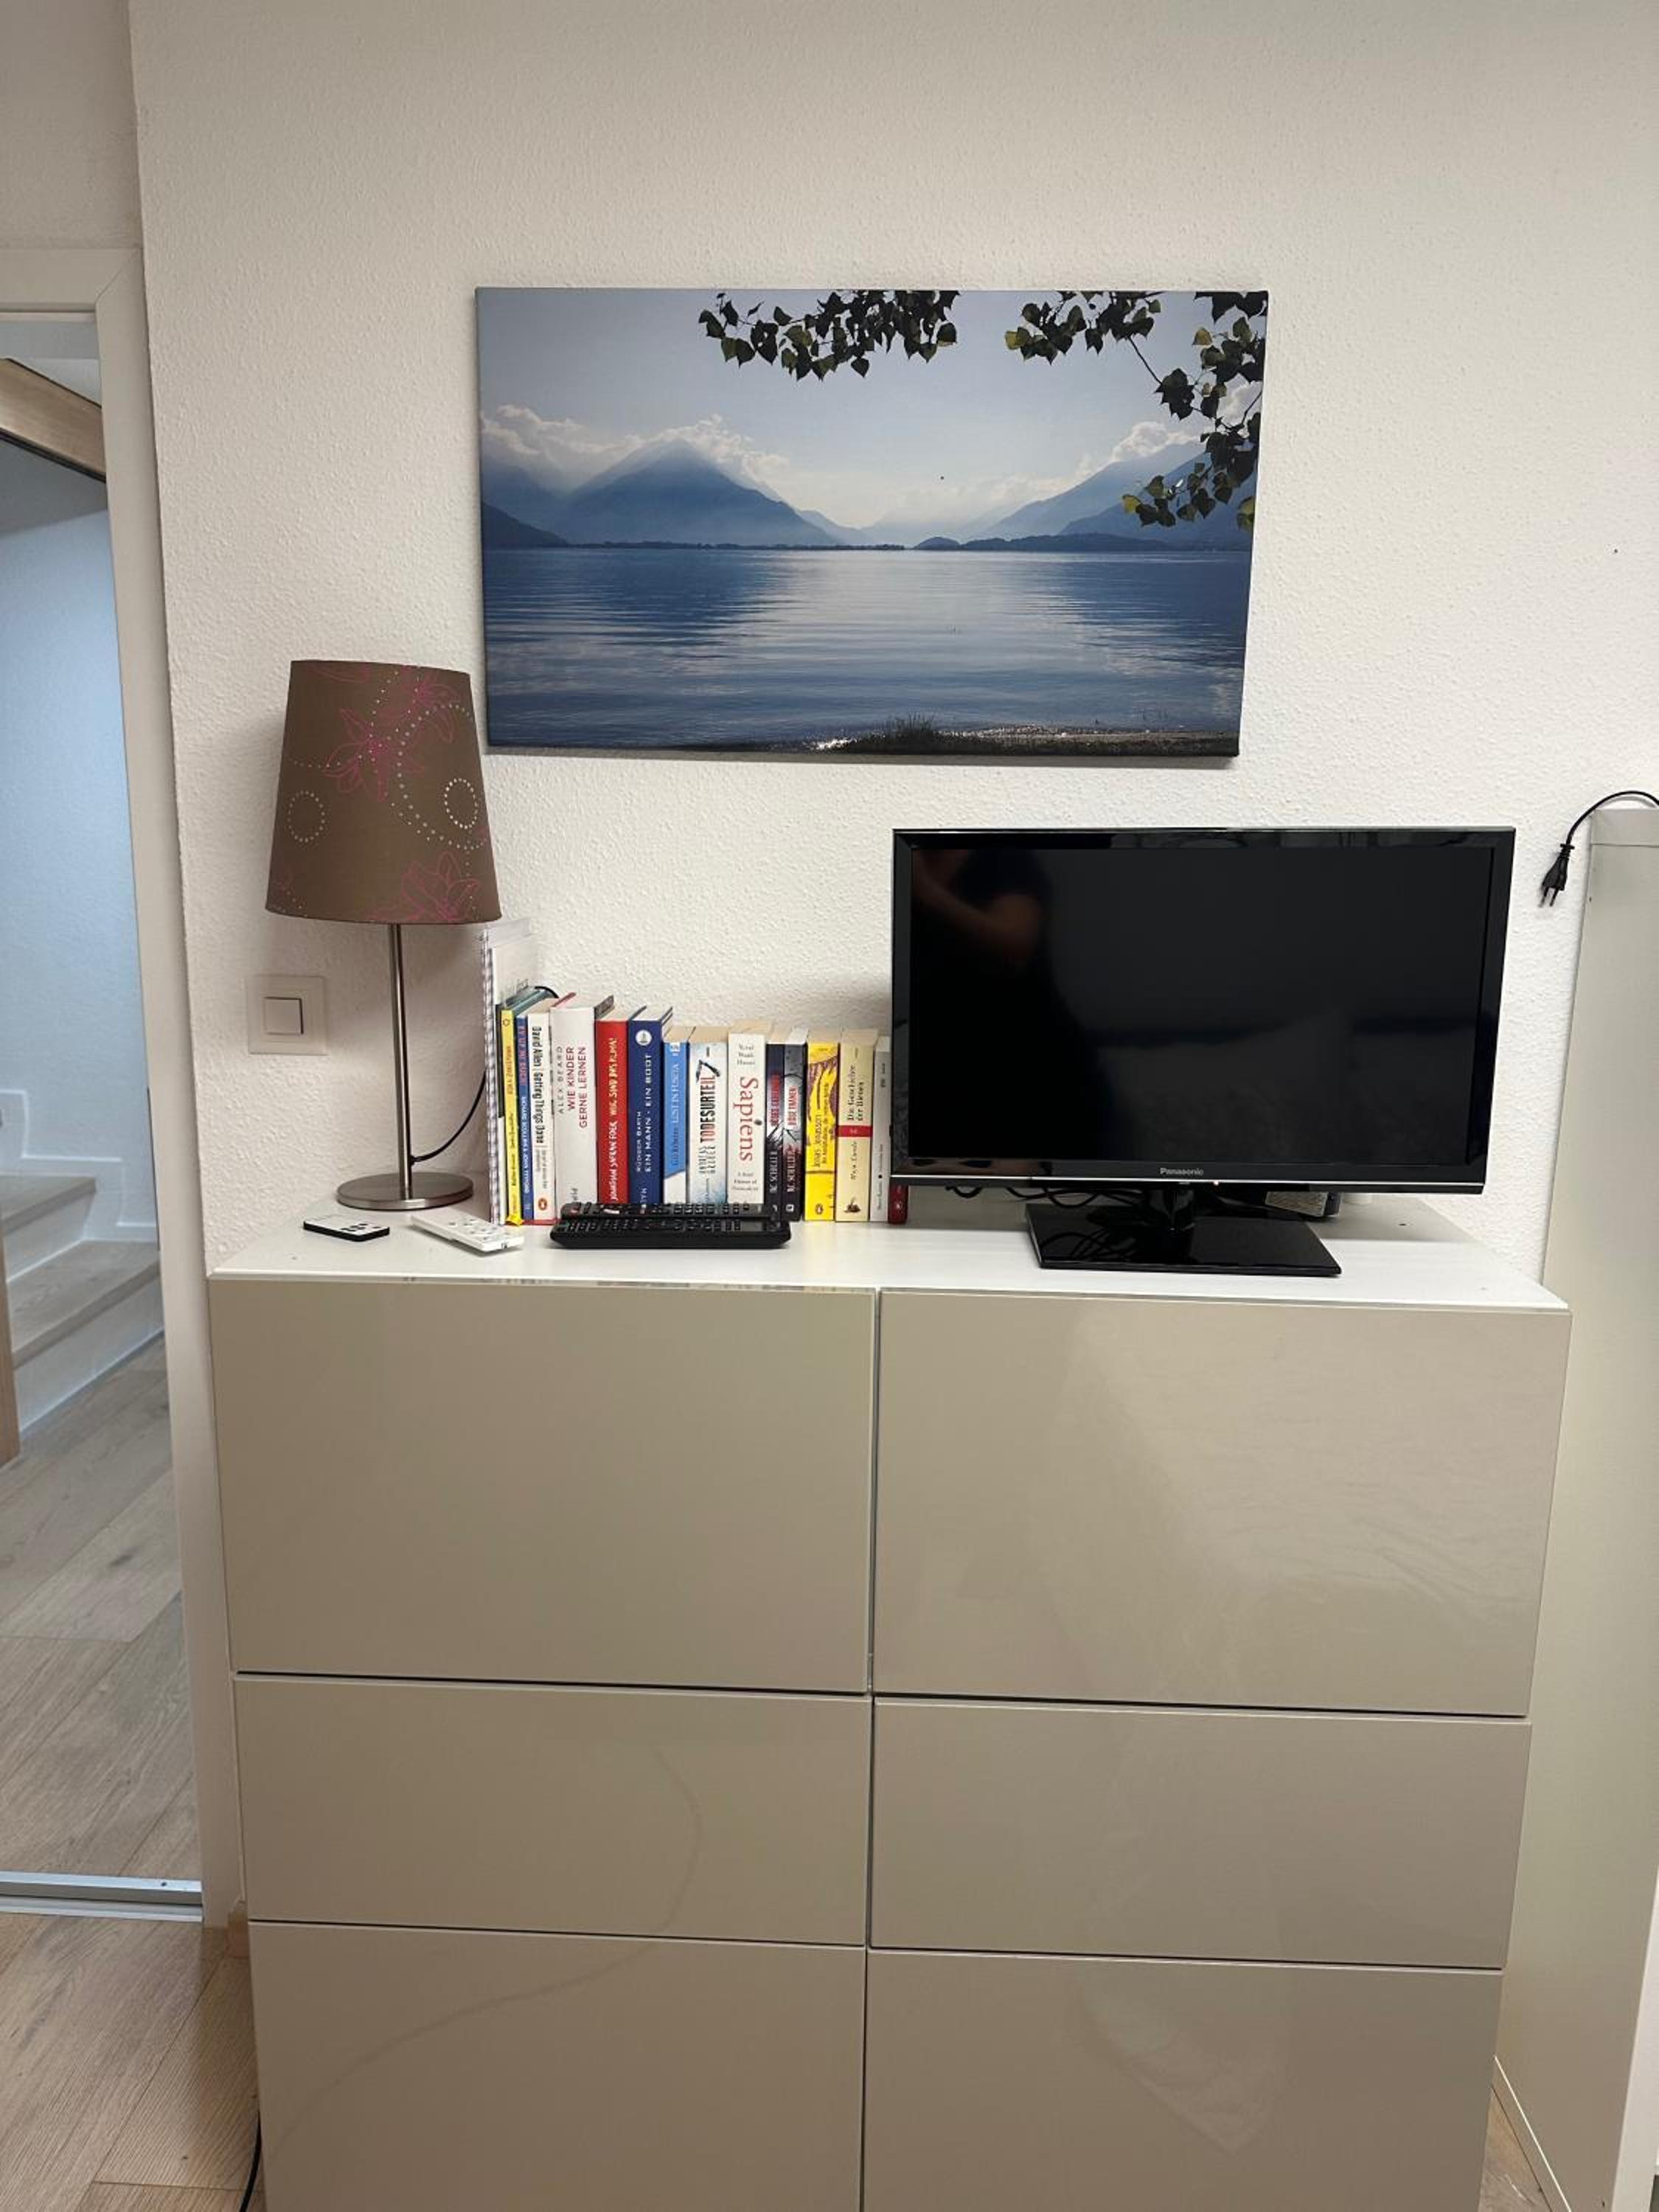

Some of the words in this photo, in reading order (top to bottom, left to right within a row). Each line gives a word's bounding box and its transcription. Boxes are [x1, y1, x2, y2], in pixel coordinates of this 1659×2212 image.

[532, 1026, 543, 1047] David
[533, 1048, 543, 1066] Allen
[566, 1047, 575, 1087] KINDER
[578, 1047, 587, 1089] LERNEN
[608, 1063, 617, 1077] DAS
[532, 1072, 543, 1099] Getting
[609, 1079, 617, 1097] SIND
[847, 1065, 856, 1105] Geschichte
[856, 1082, 864, 1107] Bienen
[532, 1100, 546, 1124] Things
[567, 1091, 576, 1110] WIE
[580, 1093, 588, 1128] GERNE
[700, 1075, 715, 1143] TODESURTEIL
[609, 1121, 617, 1139] FOER
[733, 1077, 759, 1162] Sapiens
[813, 1114, 822, 1145] Jonasson
[535, 1125, 544, 1143] Done
[812, 1150, 821, 1167] Jonas
[1160, 1167, 1204, 1176] Panasonic
[609, 1169, 618, 1200] JONATHAN
